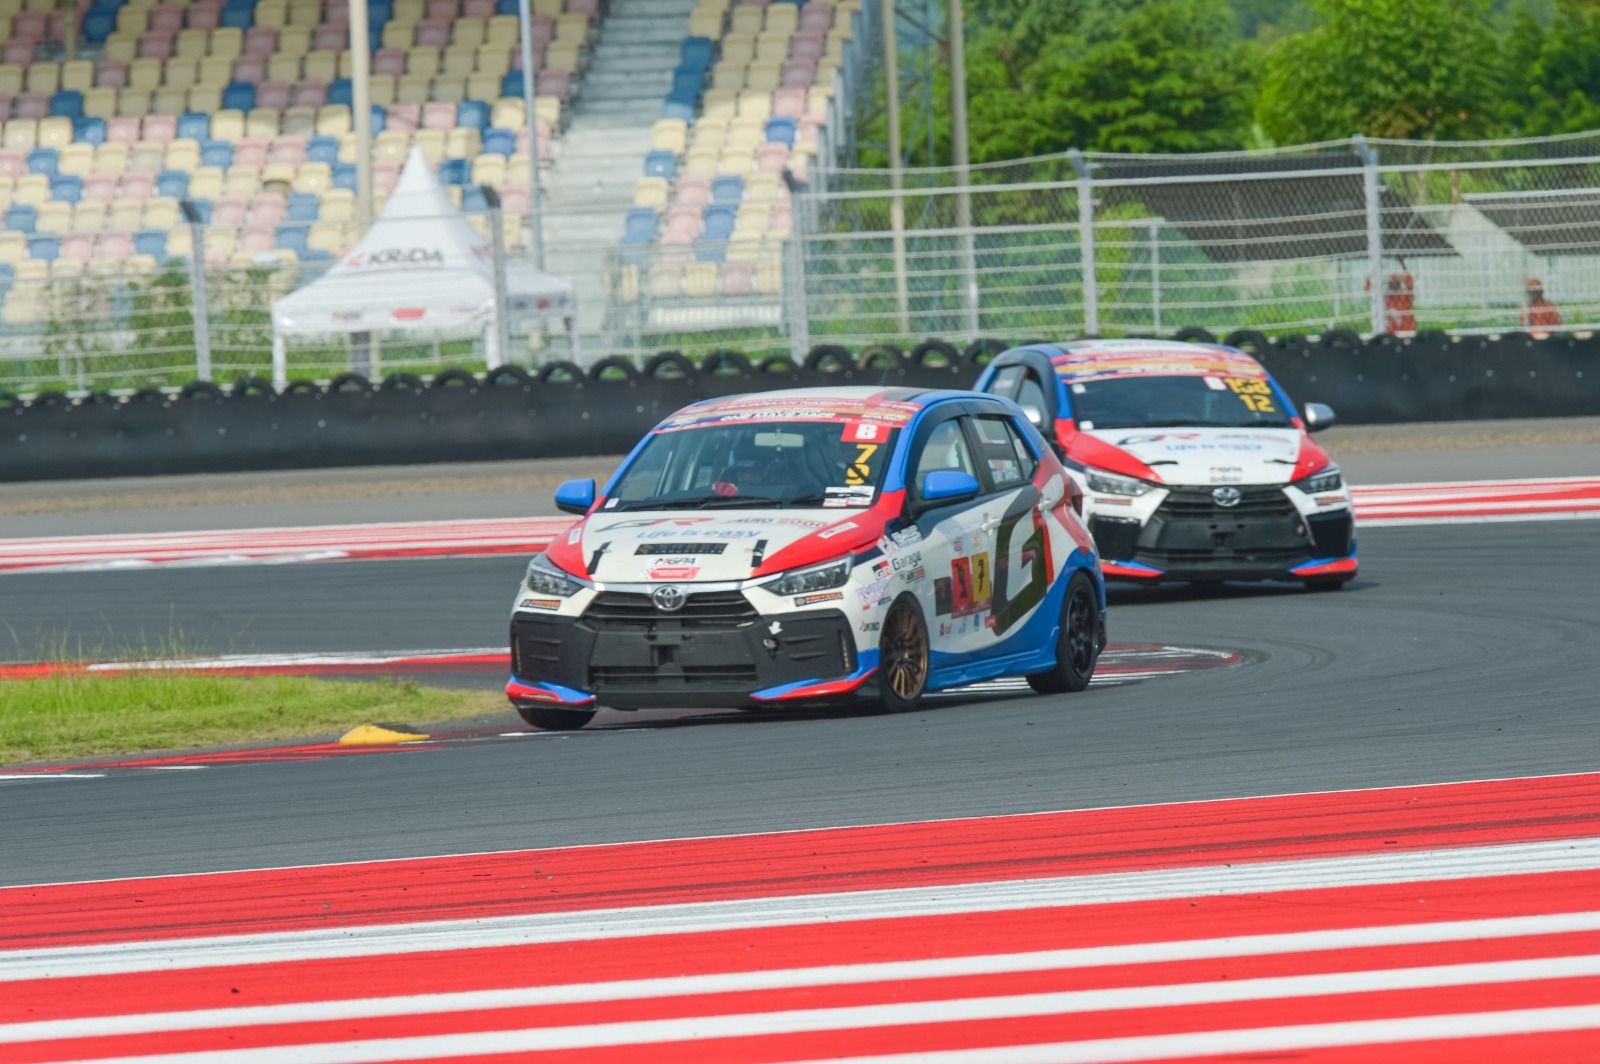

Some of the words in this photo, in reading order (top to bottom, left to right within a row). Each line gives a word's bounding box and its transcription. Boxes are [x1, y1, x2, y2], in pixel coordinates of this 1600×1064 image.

[1239, 394, 1276, 413] 12
[855, 423, 878, 440] B
[854, 443, 878, 464] 7
[636, 530, 676, 539] Life
[681, 529, 698, 537] is
[703, 530, 763, 539] easy
[891, 551, 922, 571] Garage
